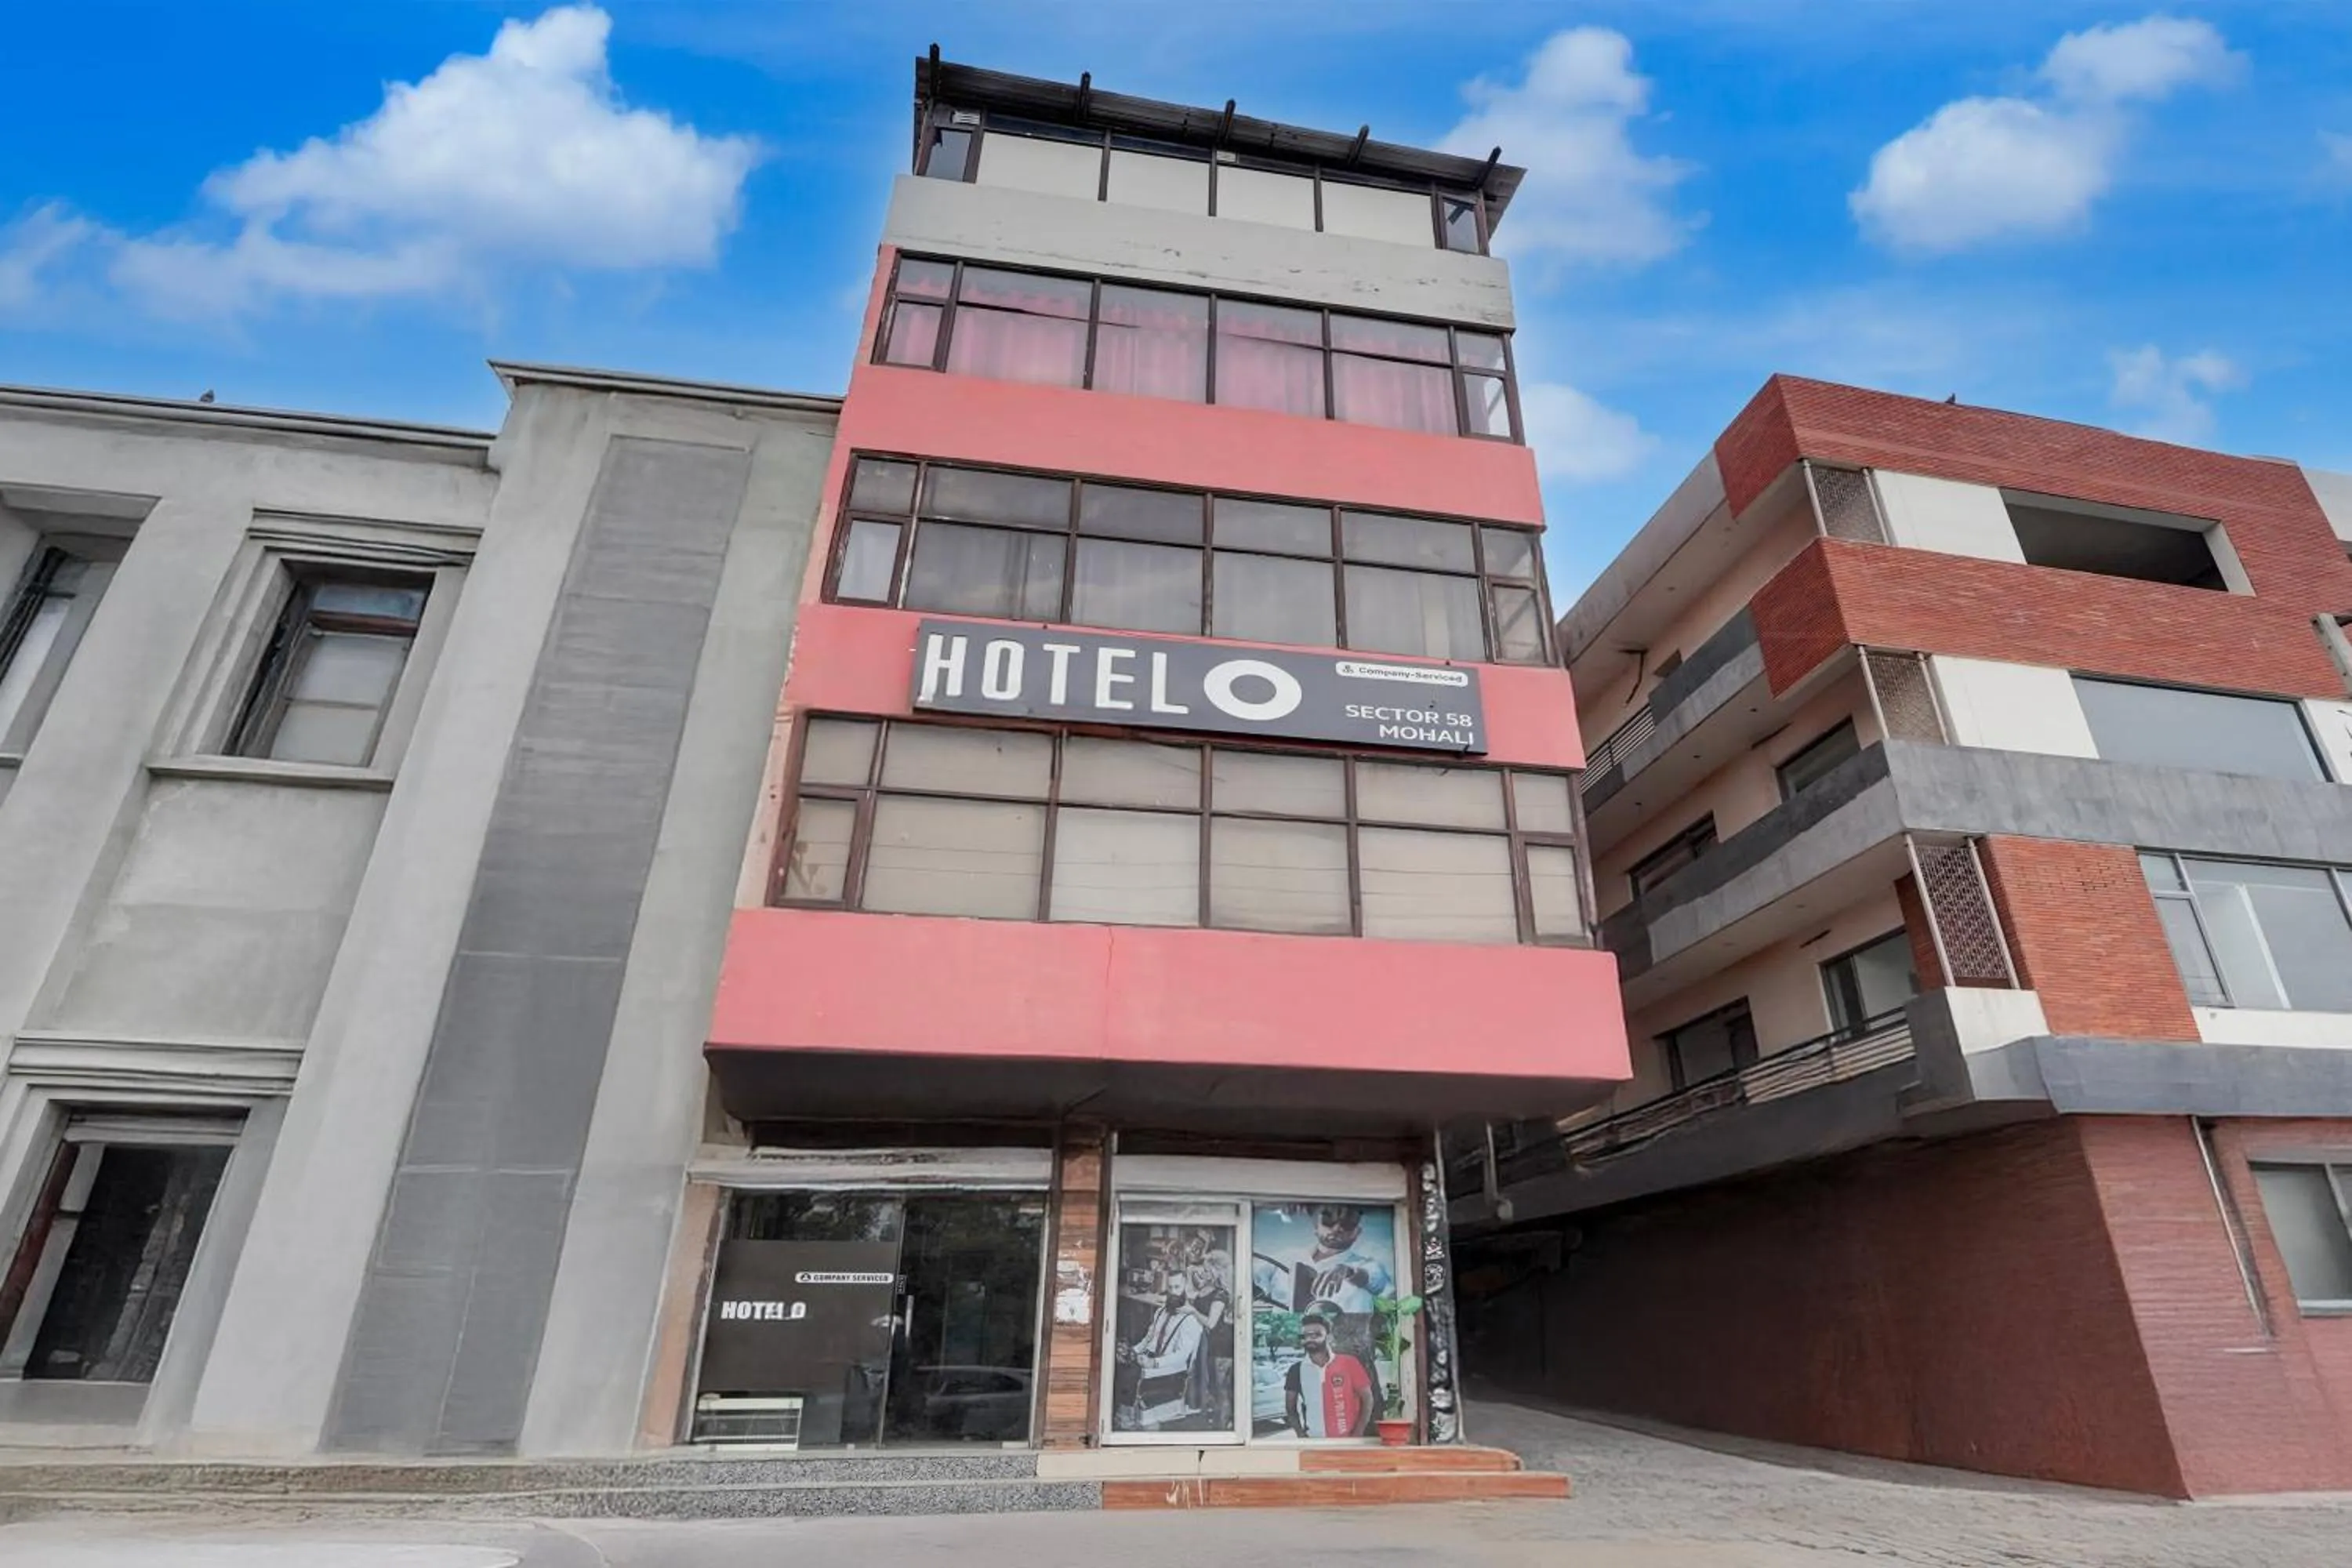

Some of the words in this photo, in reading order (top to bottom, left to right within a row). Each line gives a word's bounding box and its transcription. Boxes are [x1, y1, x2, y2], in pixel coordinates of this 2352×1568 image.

[917, 634, 1189, 714] HOTEL
[1345, 704, 1439, 724] SECTOR
[1446, 713, 1473, 728] 58
[1379, 724, 1474, 746] MOHALI
